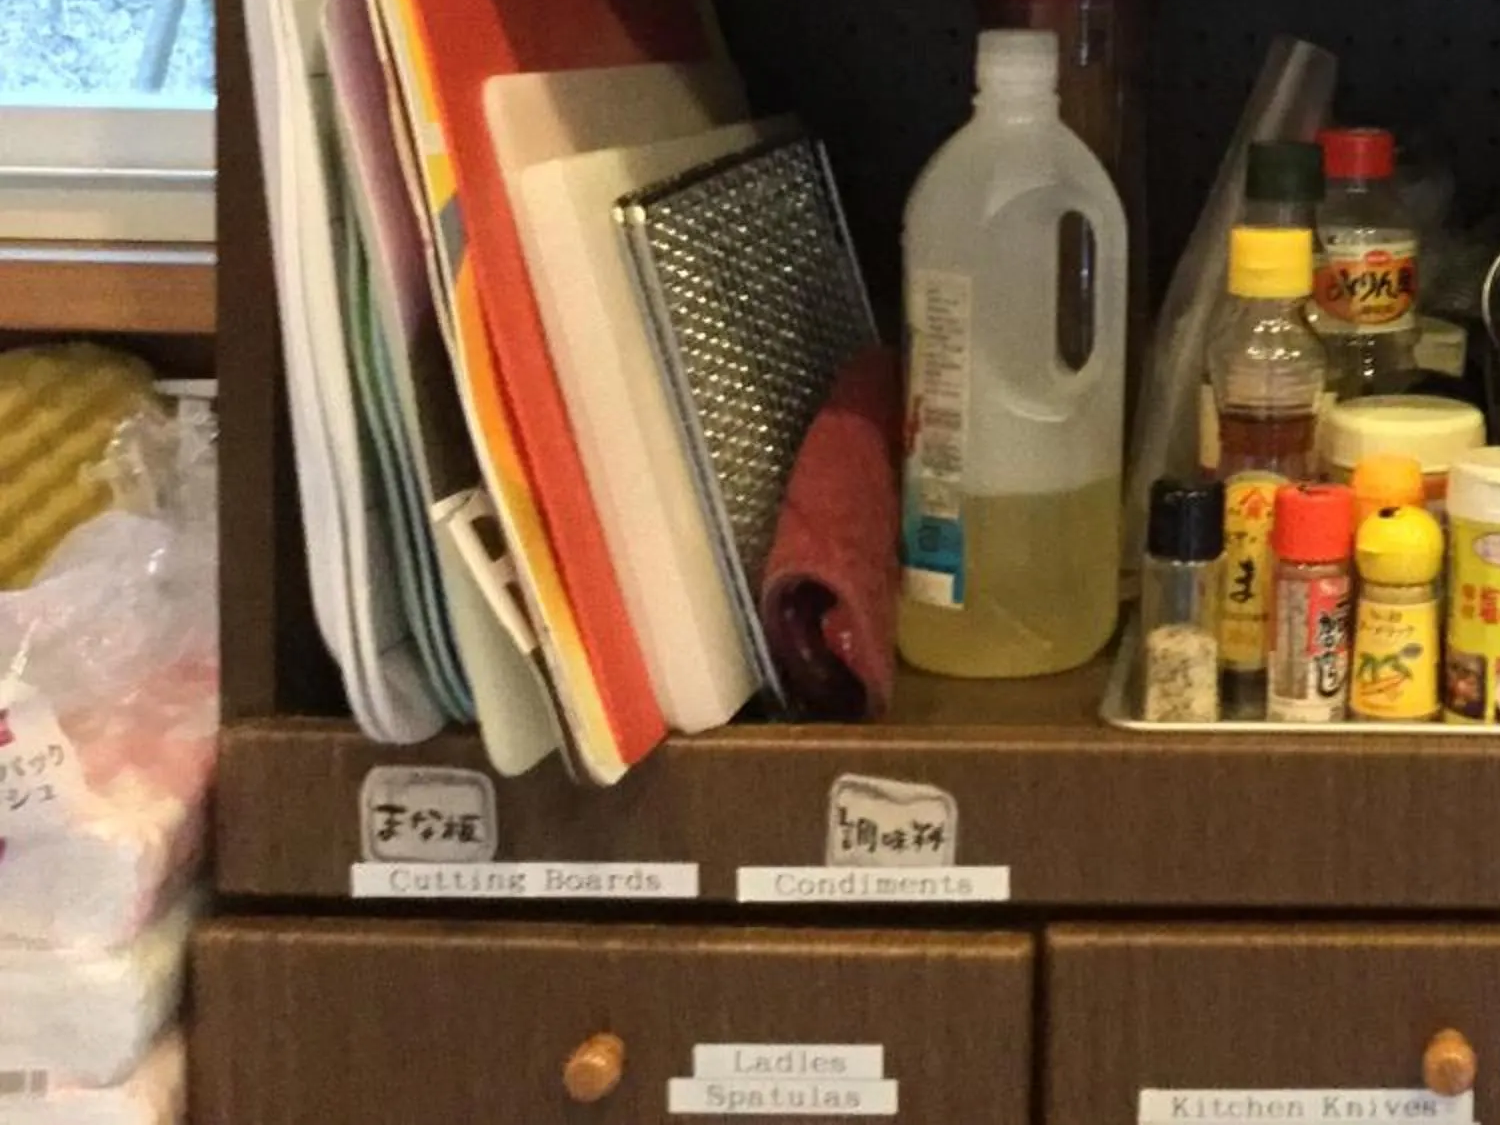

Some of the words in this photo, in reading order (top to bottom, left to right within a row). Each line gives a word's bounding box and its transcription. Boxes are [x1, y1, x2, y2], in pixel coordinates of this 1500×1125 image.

[388, 868, 526, 894] Cutting
[543, 868, 662, 892] Boards
[774, 872, 974, 897] Condiments
[733, 1050, 848, 1075] Ladles
[704, 1084, 862, 1110] Spatulas
[1171, 1095, 1304, 1118] Kitchen
[1321, 1094, 1438, 1119] Knives
